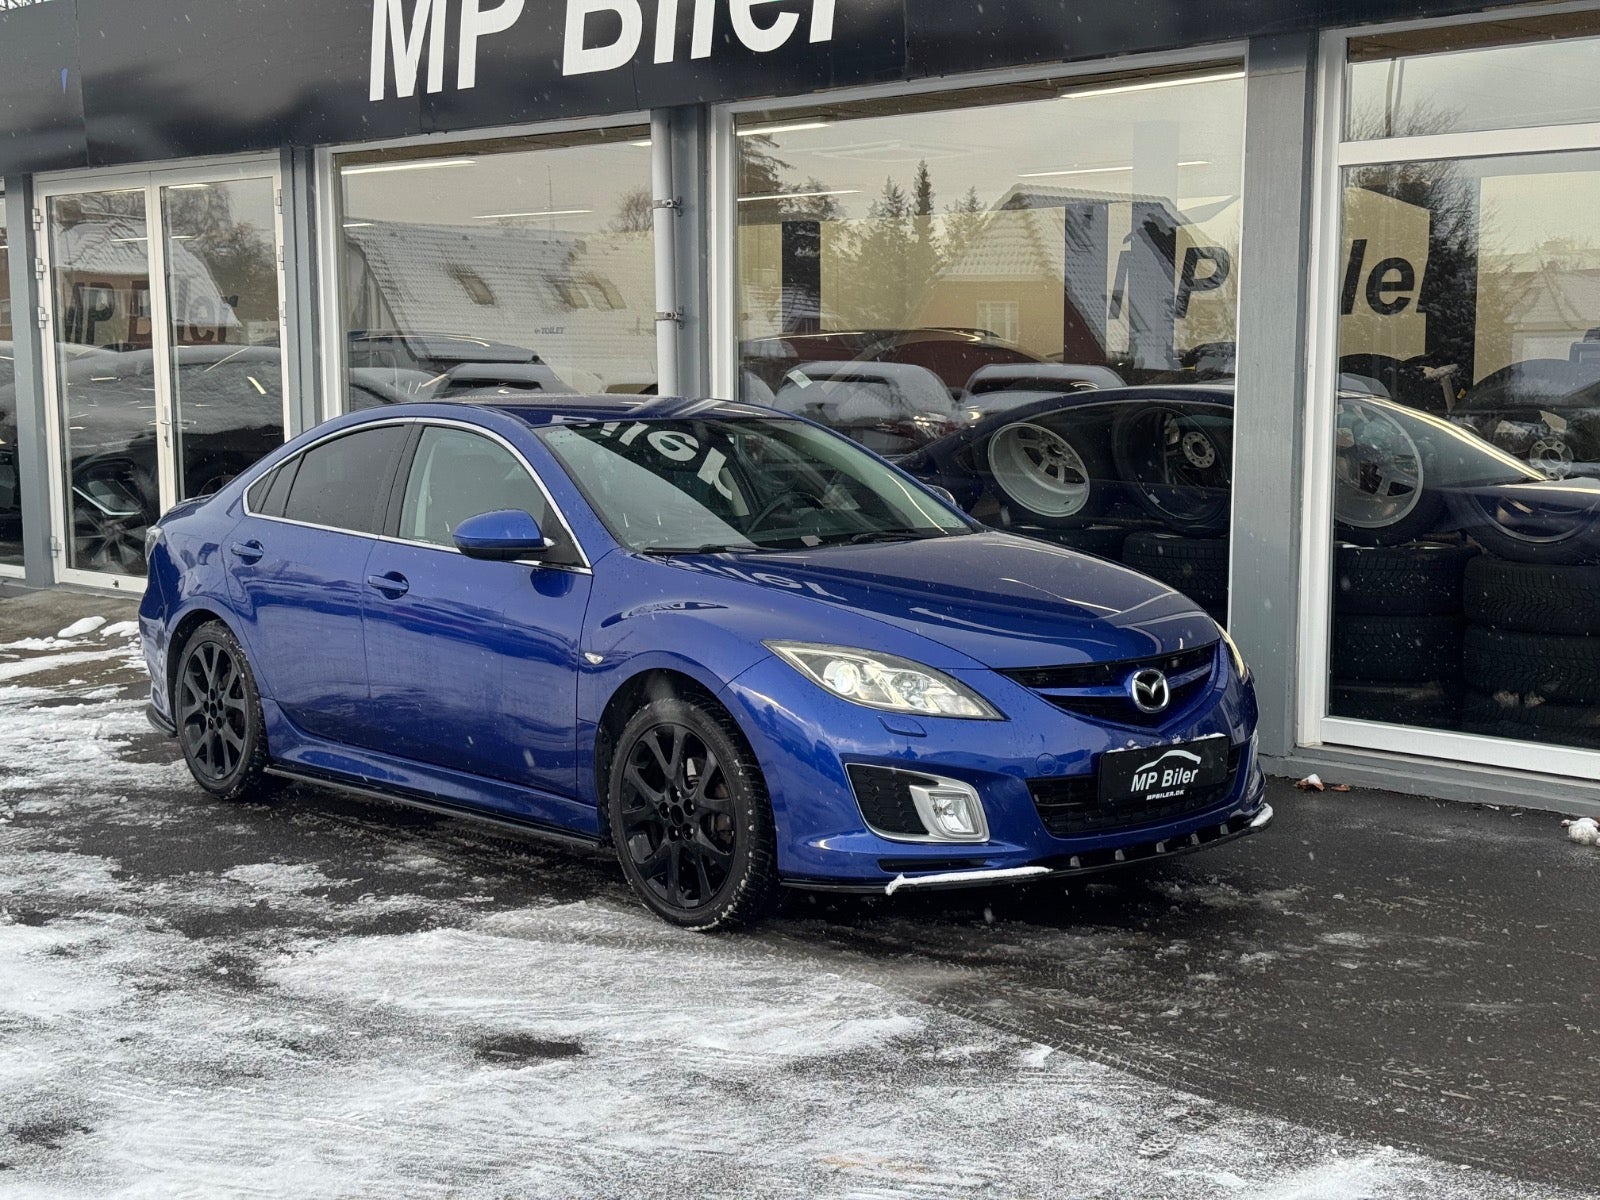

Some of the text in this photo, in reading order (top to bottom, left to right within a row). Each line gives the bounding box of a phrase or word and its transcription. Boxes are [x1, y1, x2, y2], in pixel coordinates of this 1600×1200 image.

[369, 0, 522, 101] MP
[1130, 767, 1199, 793] MP Biler
[1145, 789, 1185, 801] MPBILER.DK
